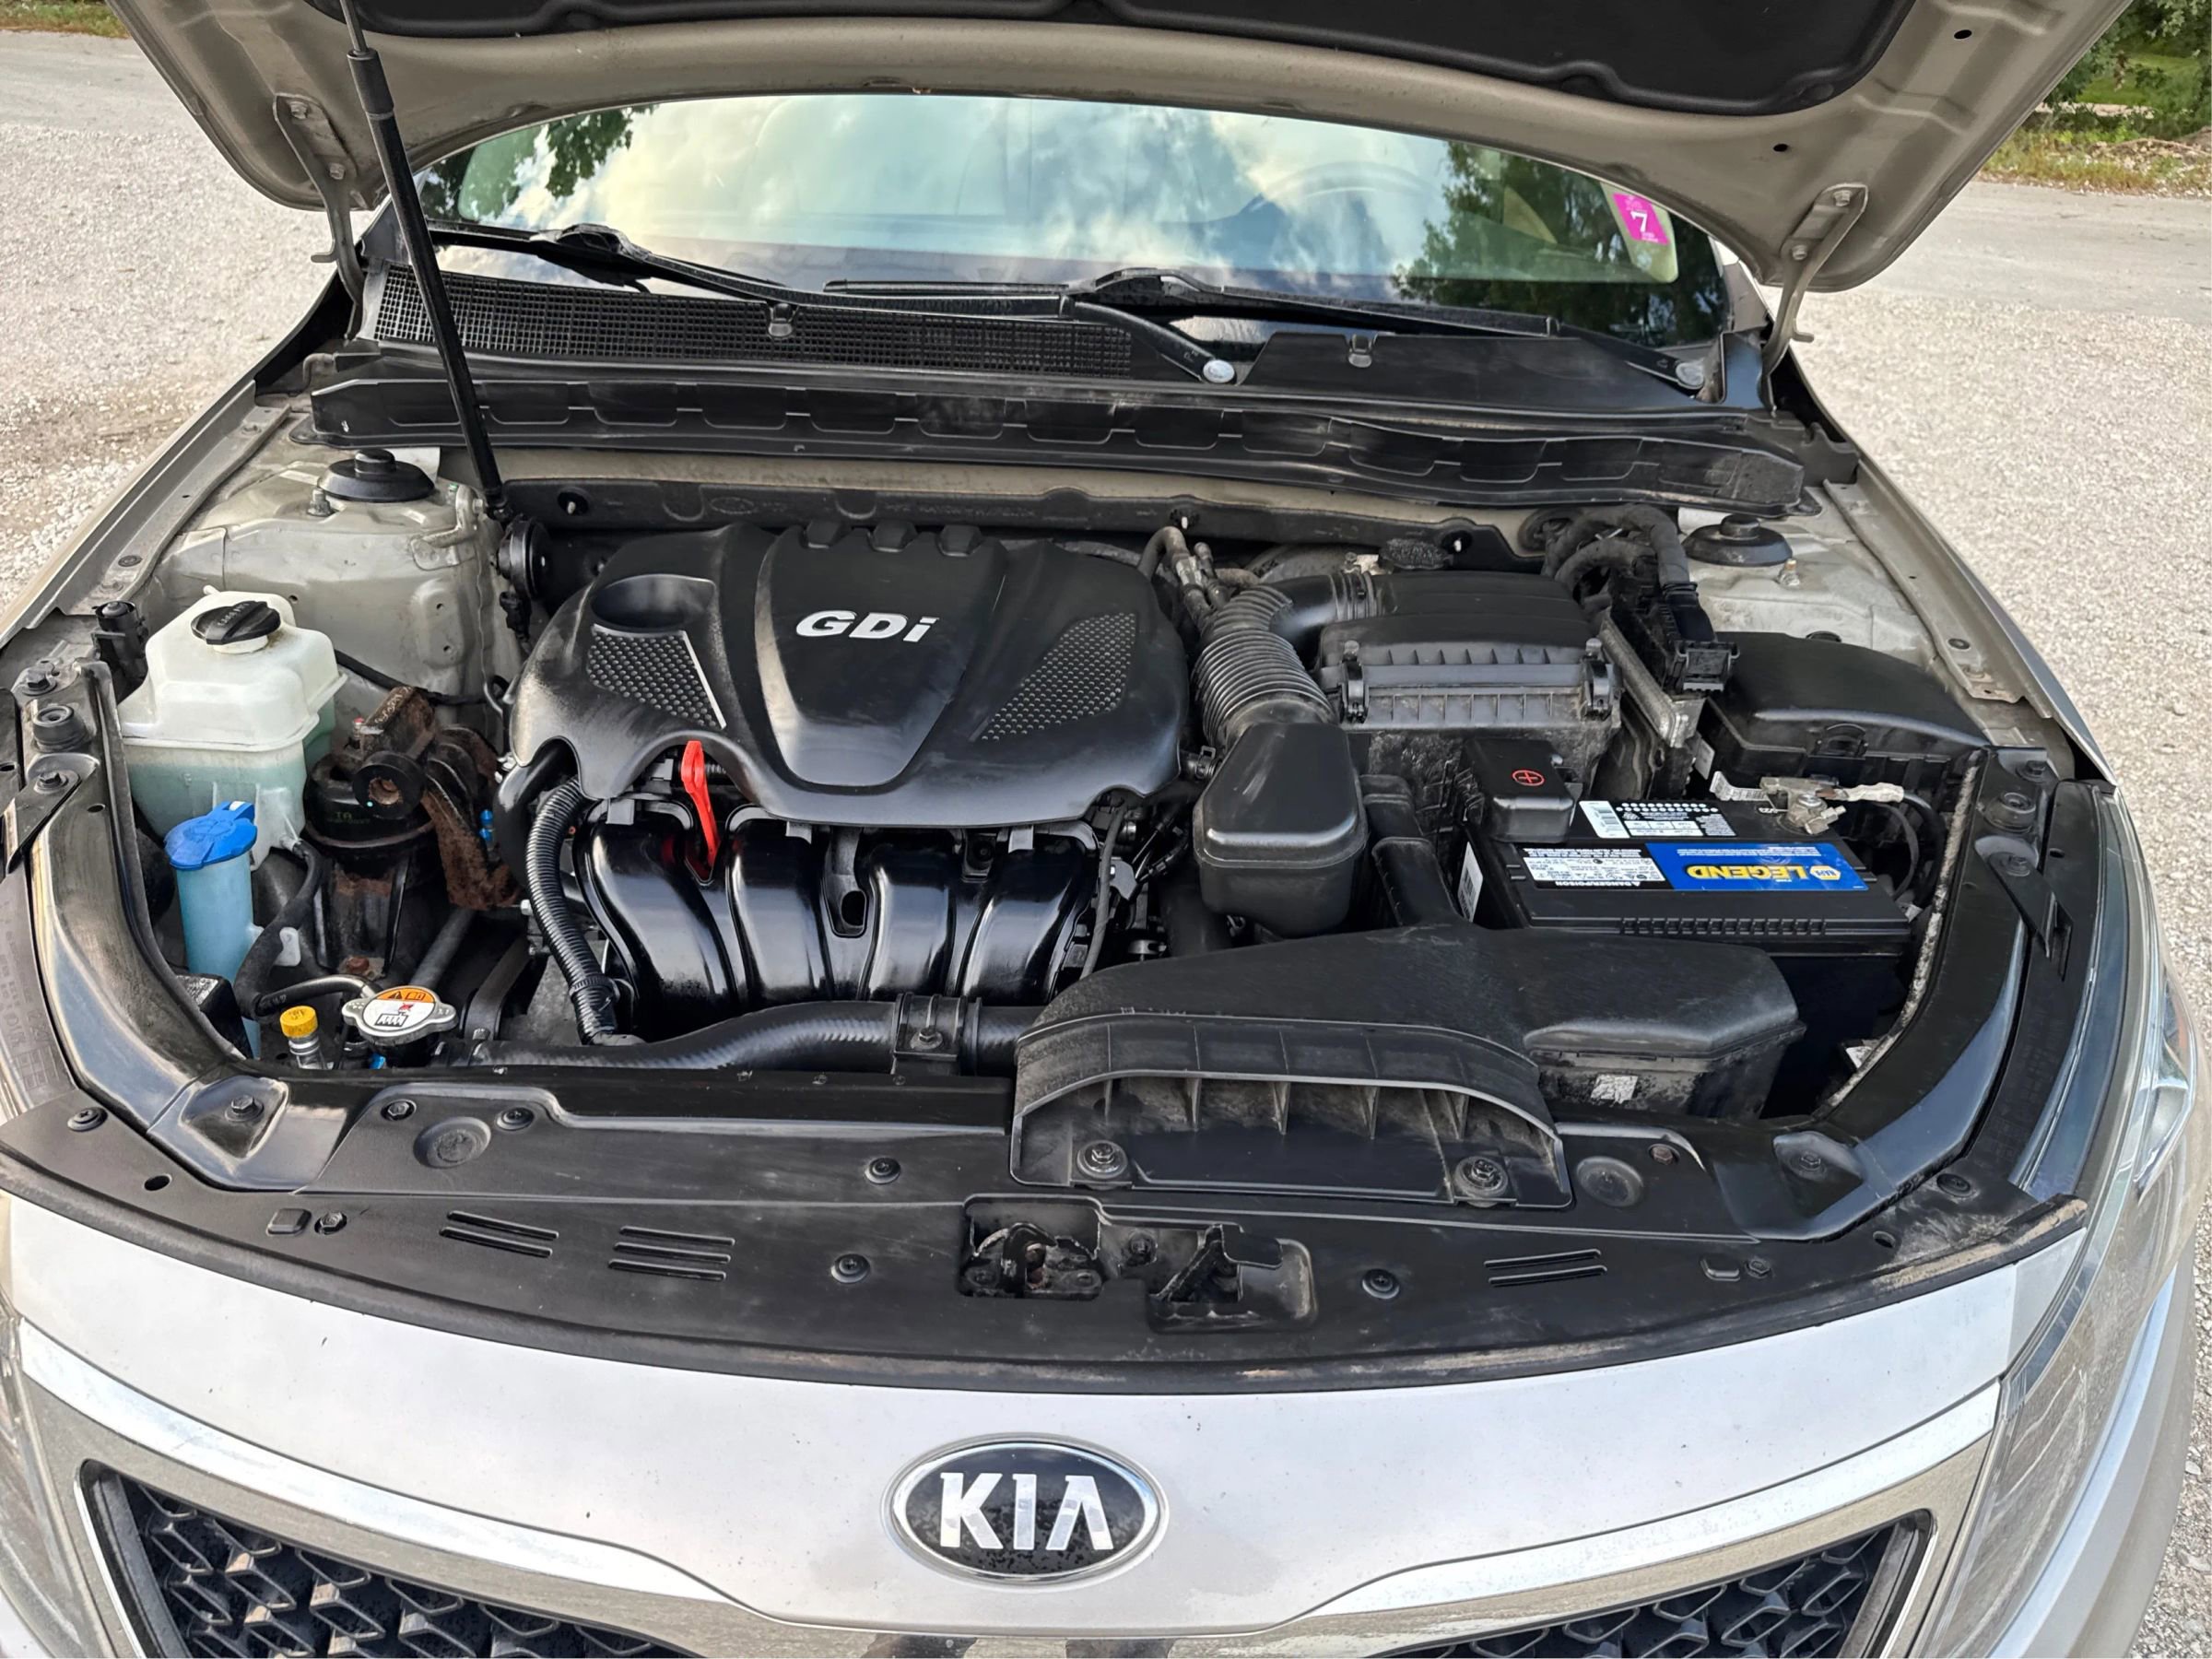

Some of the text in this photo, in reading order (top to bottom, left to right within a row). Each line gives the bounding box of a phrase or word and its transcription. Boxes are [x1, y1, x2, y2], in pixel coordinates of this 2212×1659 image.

[1630, 211, 1648, 232] 7
[796, 609, 939, 642] GDi
[1687, 865, 1809, 880] LEGEND
[939, 1472, 1114, 1551] KIA
